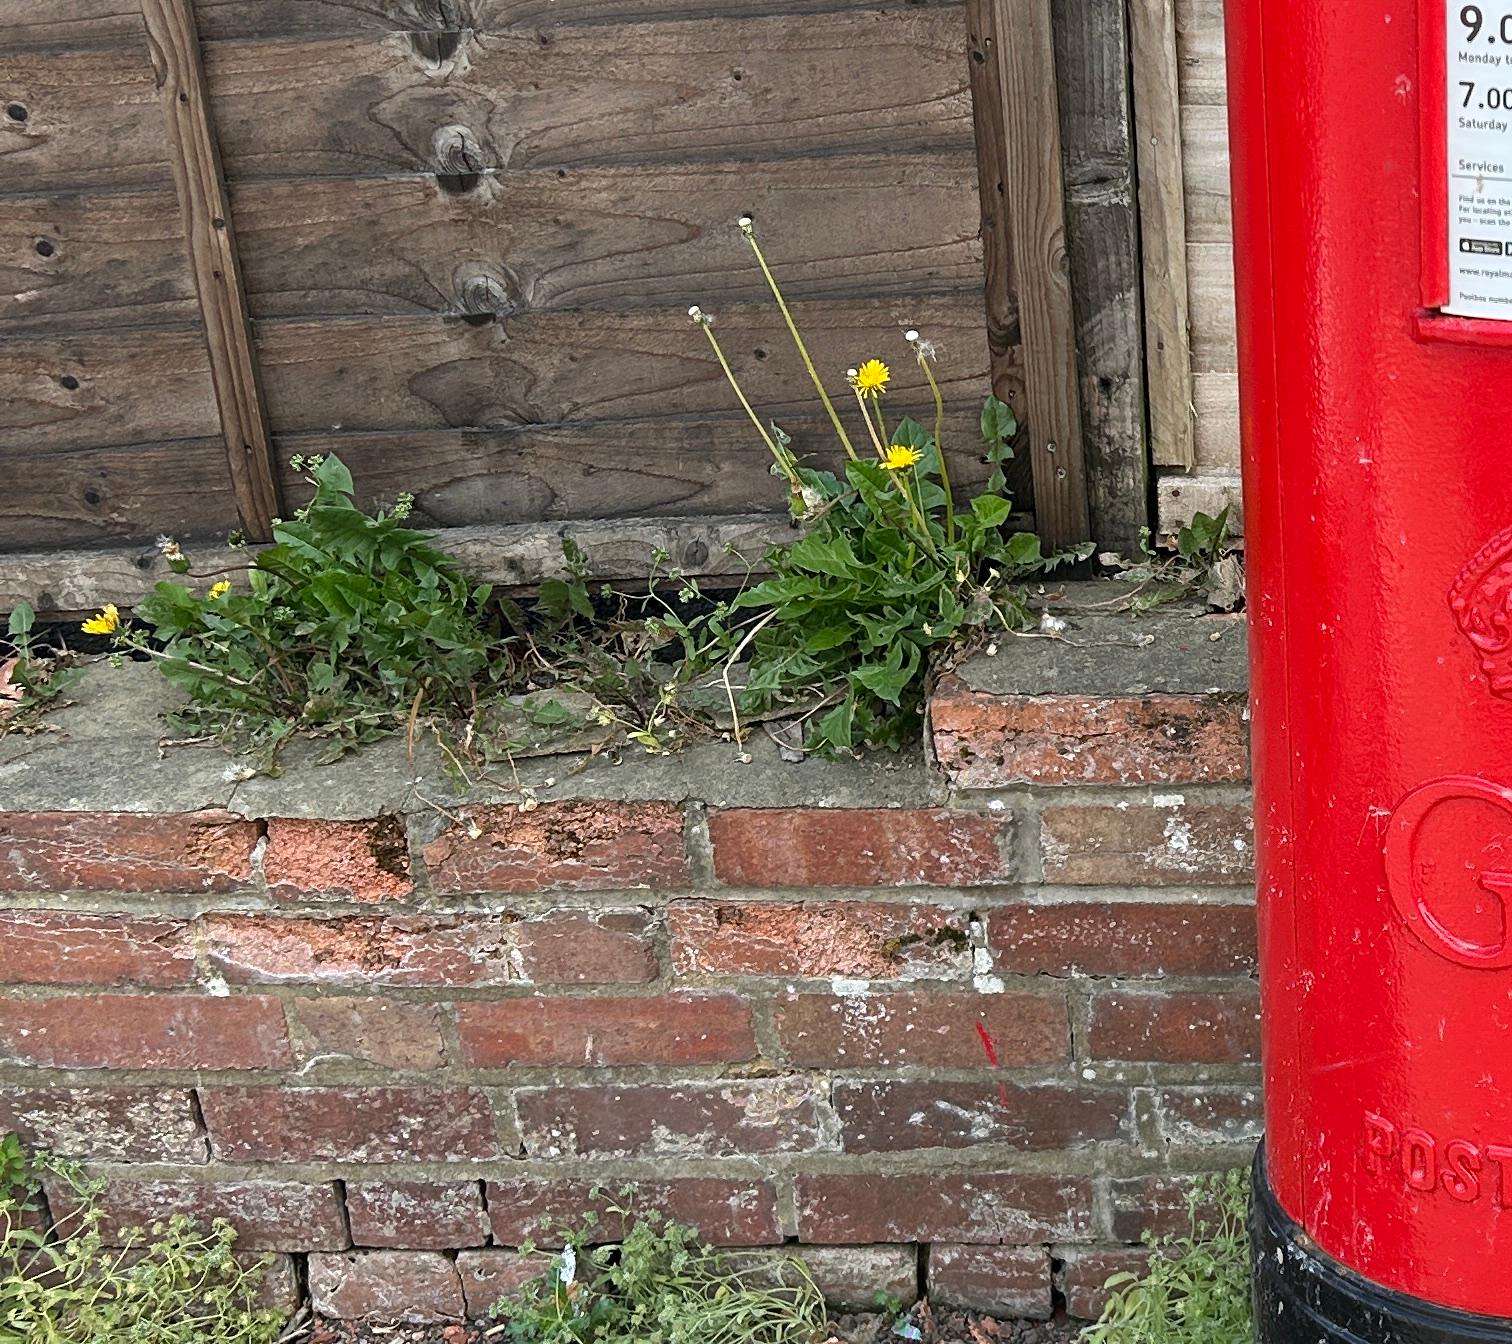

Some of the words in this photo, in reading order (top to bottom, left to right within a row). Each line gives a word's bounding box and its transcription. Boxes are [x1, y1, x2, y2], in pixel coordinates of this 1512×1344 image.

[1458, 52, 1502, 67] Monday
[1458, 116, 1508, 133] Saturday
[1458, 158, 1504, 173] Services
[1498, 197, 1511, 206] the
